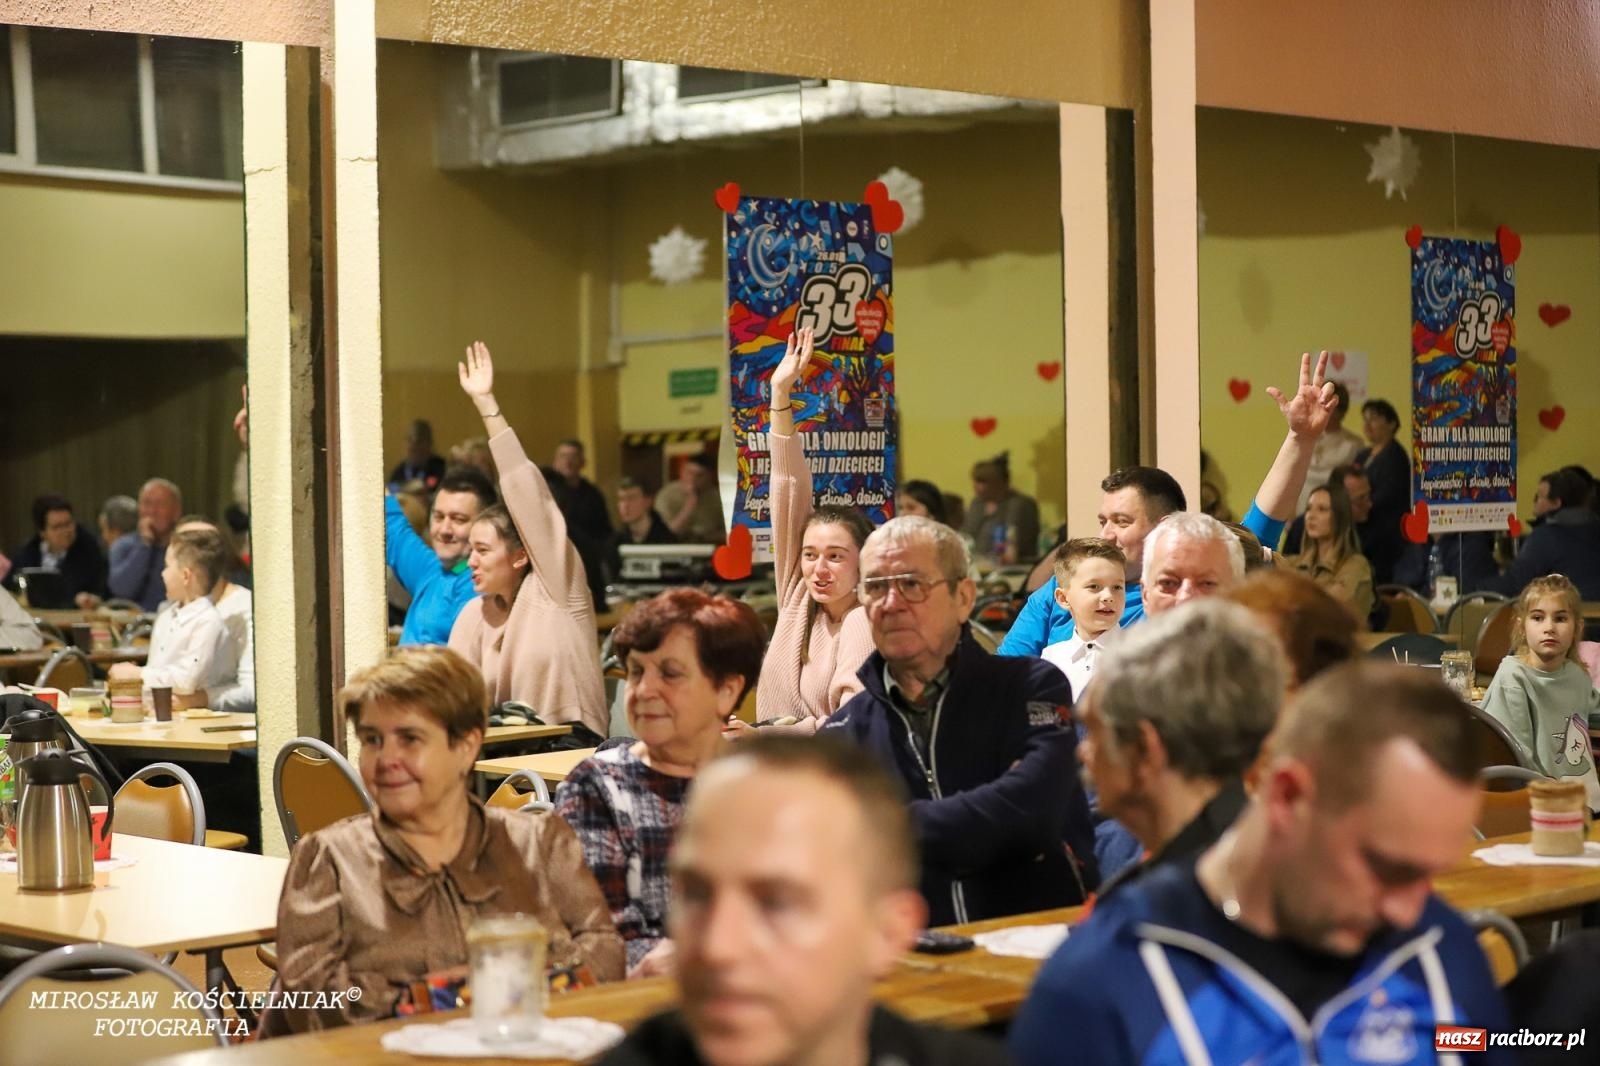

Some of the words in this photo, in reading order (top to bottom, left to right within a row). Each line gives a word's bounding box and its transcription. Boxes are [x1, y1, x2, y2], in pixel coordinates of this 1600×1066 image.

[796, 263, 871, 346] 33
[1455, 290, 1501, 359] 33
[823, 431, 885, 451] ONKOLOGII
[1421, 426, 1450, 443] GRAMY
[1452, 426, 1467, 442] DLA
[1469, 426, 1510, 442] ONKOLOGII
[828, 456, 885, 476] DZIECIĘCEJ
